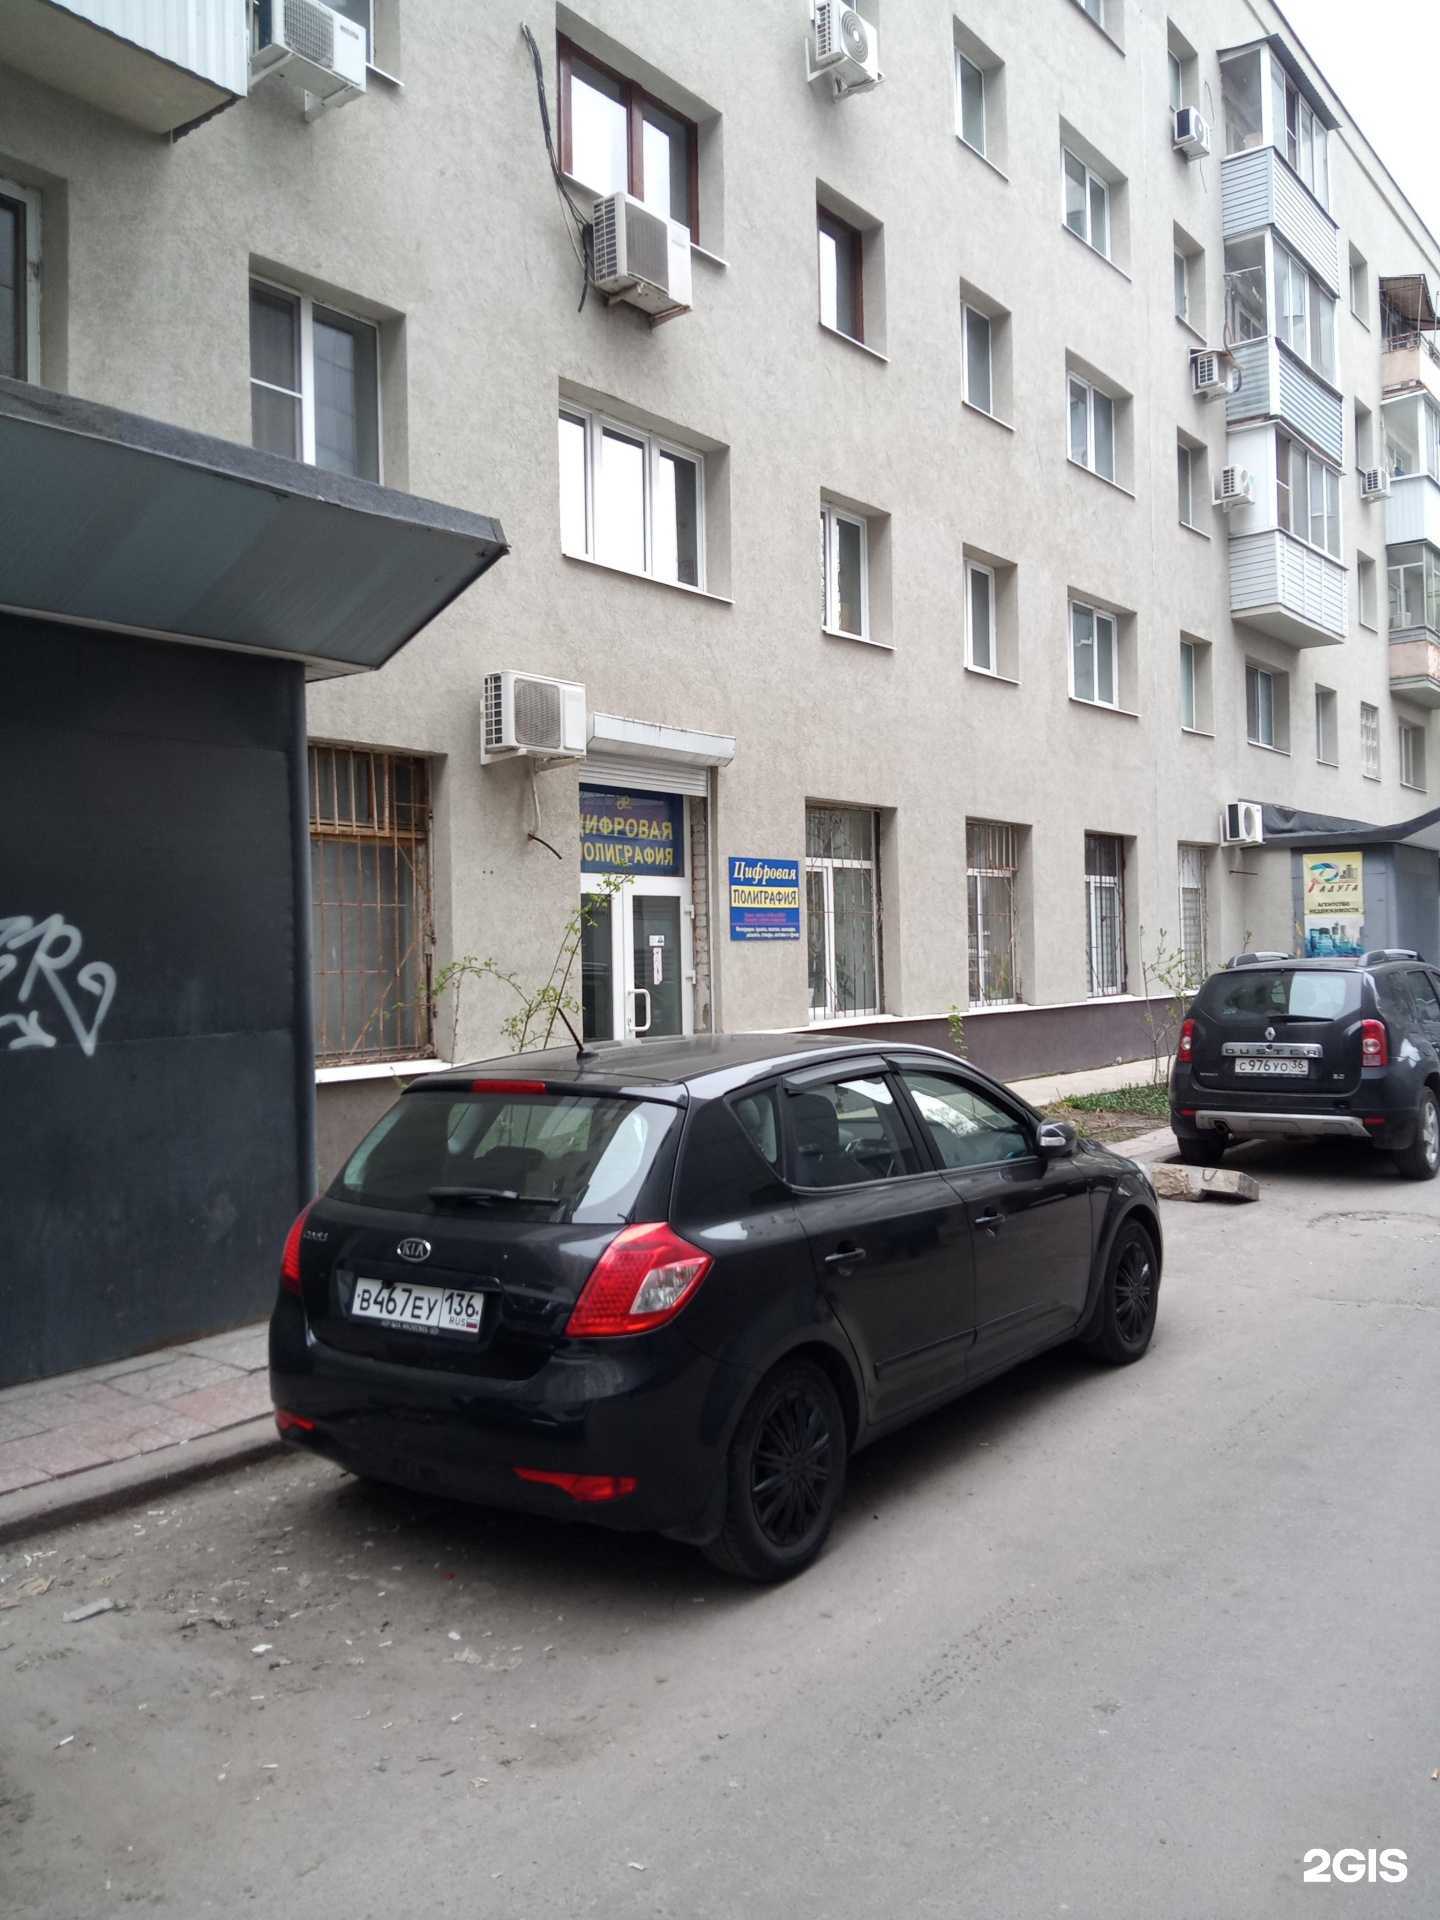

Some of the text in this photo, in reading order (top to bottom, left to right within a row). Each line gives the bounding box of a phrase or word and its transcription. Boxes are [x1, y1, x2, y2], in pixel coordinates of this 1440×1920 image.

[580, 841, 674, 866] ОЛИГРАФИЯ
[733, 861, 797, 885] Цифровая
[733, 889, 797, 905] ПОЛИГРАФИЯ
[402, 1242, 424, 1257] KIA
[359, 1285, 476, 1321] В467ЕУ 136
